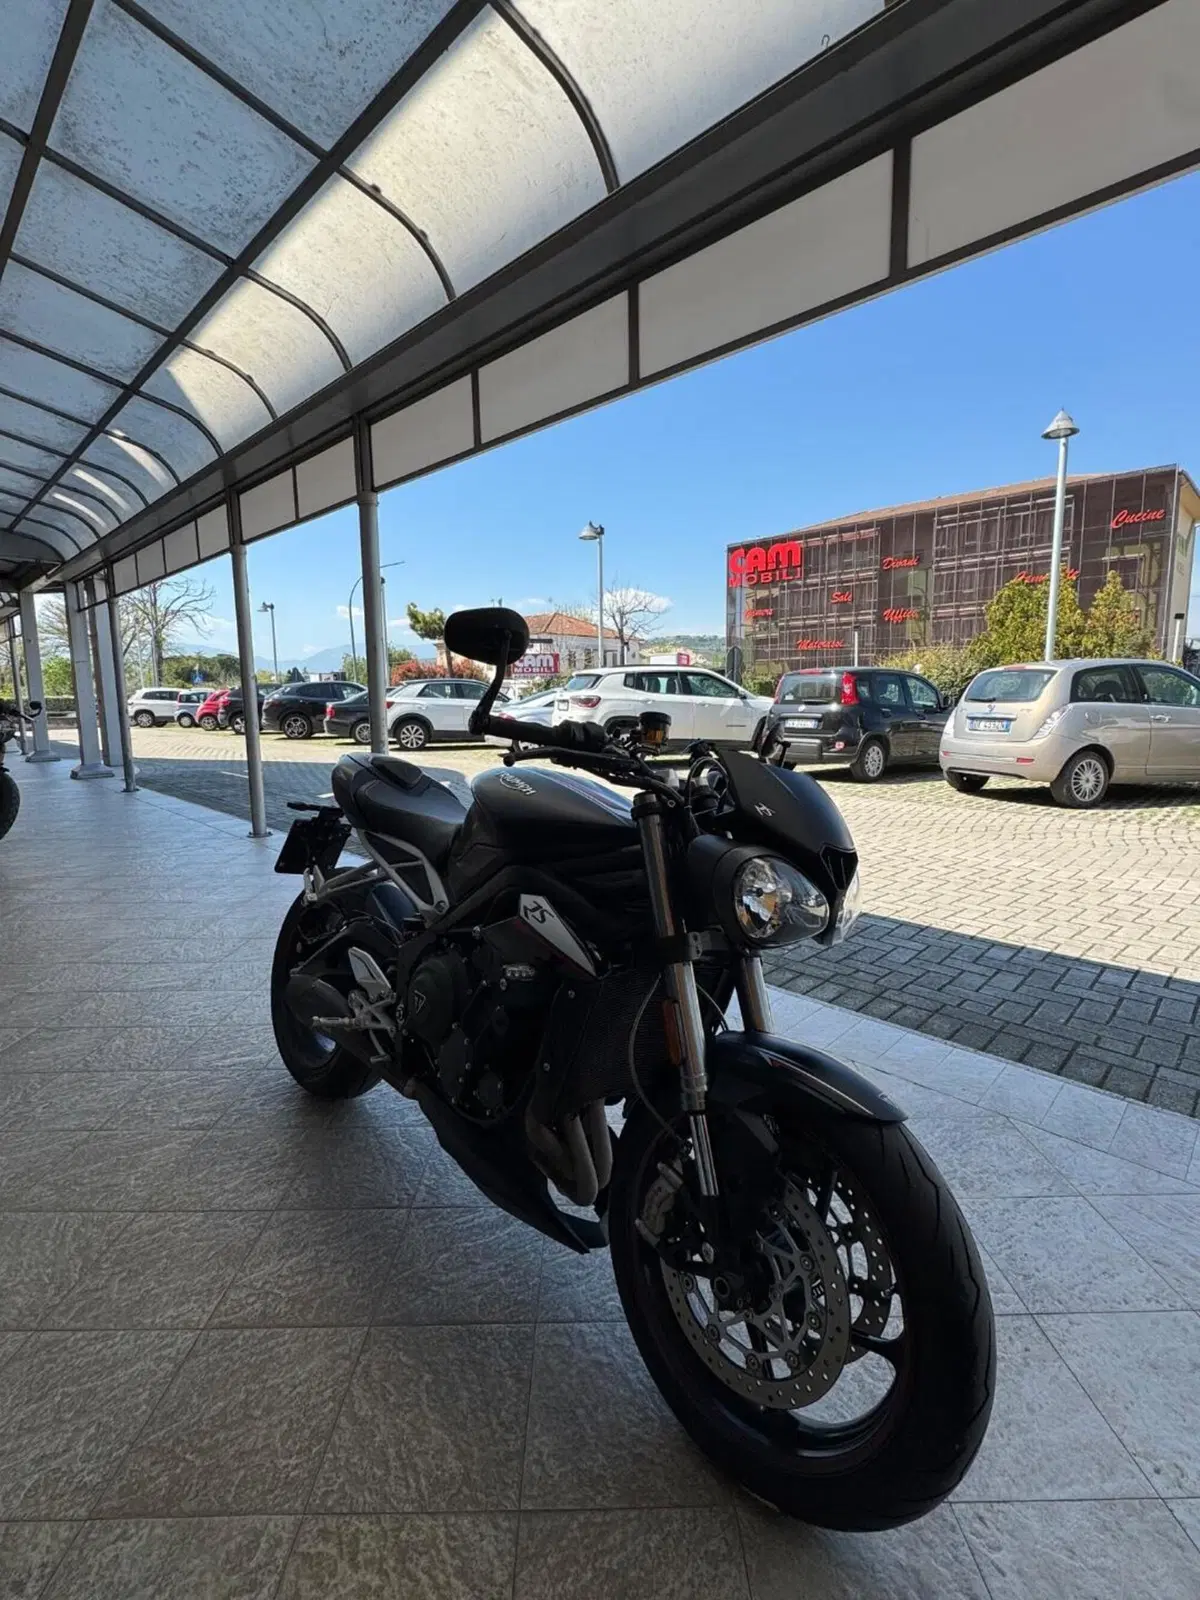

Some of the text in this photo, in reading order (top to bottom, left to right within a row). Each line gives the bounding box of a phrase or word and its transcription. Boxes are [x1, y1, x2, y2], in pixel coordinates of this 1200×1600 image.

[1110, 508, 1165, 529] Cucine
[728, 541, 801, 575] CAM
[882, 556, 920, 570] Divani
[728, 567, 802, 588] MOBILI
